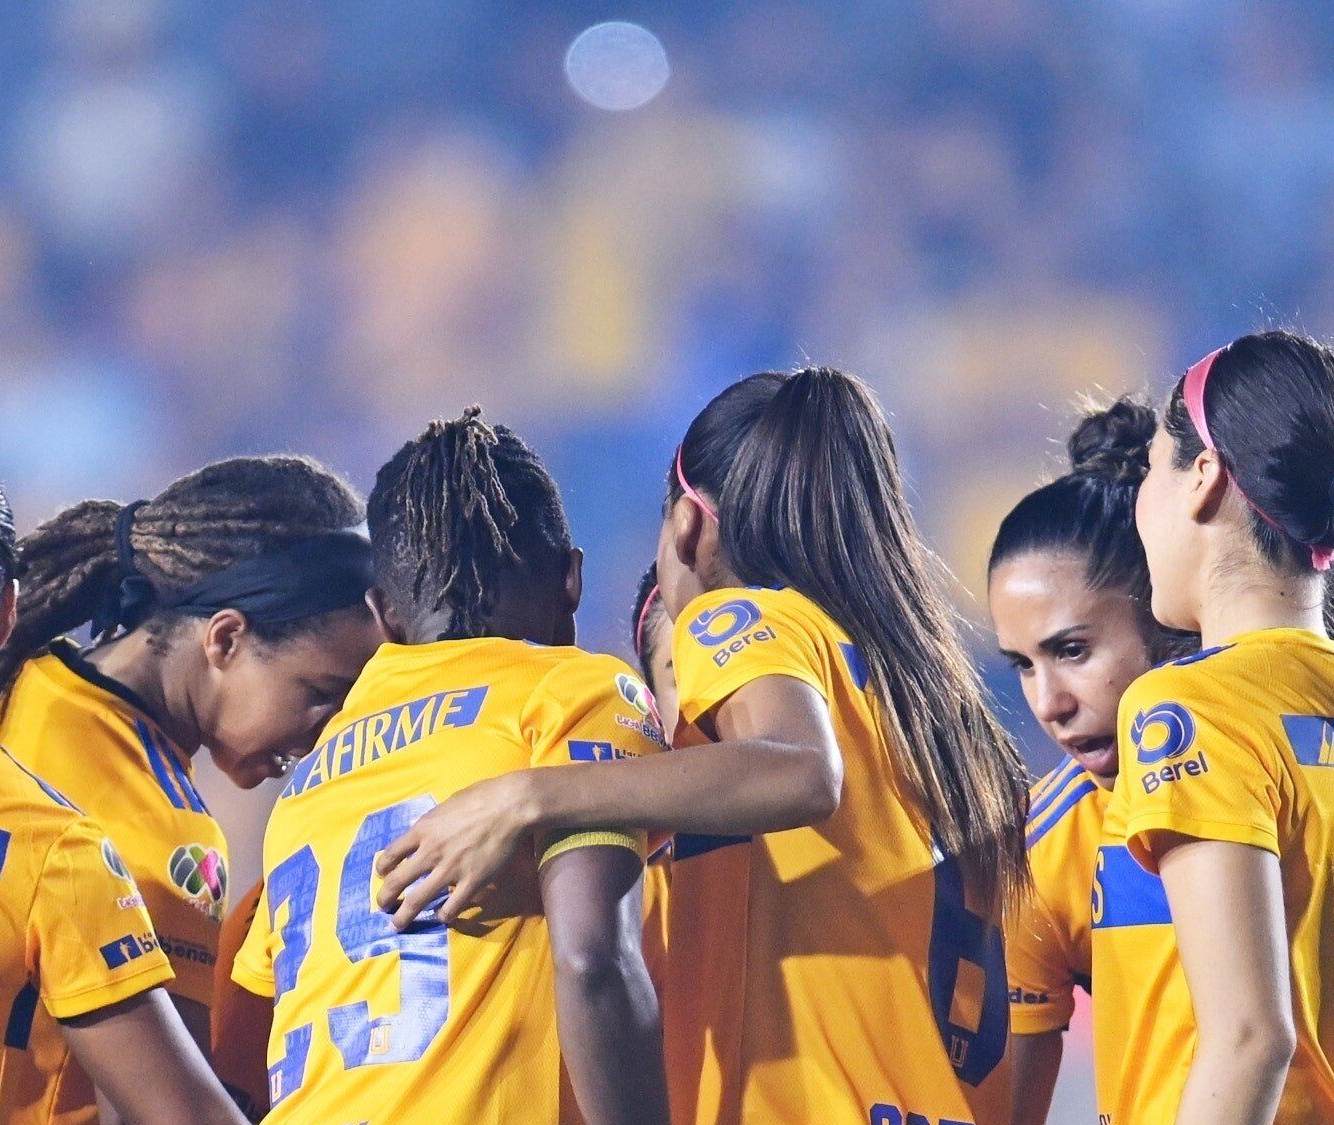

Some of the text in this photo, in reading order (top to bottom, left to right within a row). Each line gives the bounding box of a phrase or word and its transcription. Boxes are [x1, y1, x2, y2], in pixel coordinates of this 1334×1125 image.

[712, 624, 777, 668] Berel
[304, 689, 470, 791] AFIRME
[1141, 751, 1209, 795] Berel
